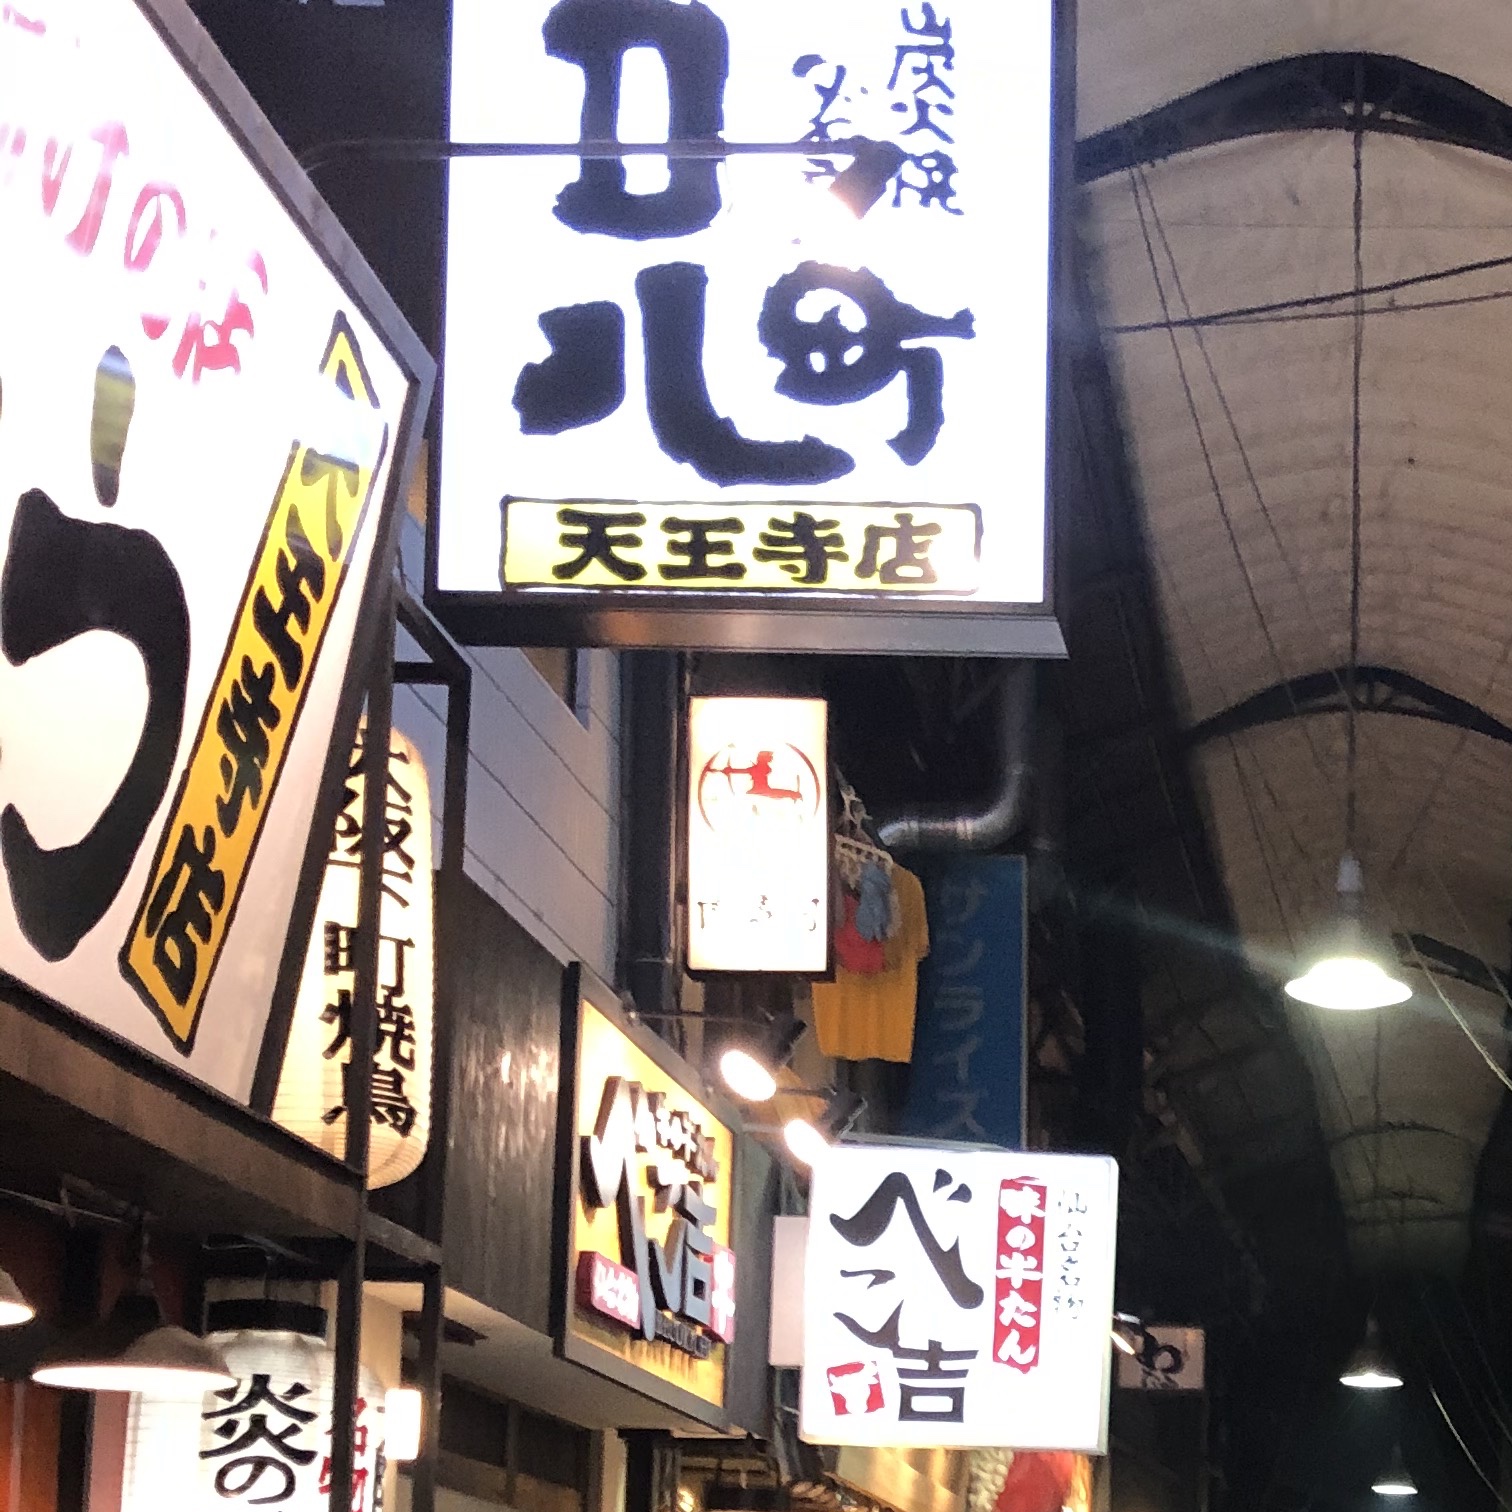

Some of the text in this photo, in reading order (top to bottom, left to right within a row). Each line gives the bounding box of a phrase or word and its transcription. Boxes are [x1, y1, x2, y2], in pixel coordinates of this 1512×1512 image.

[553, 508, 941, 584] 天王寺店
[829, 1169, 985, 1422] べこ吉
[999, 1184, 1045, 1370] 味の牛たん
